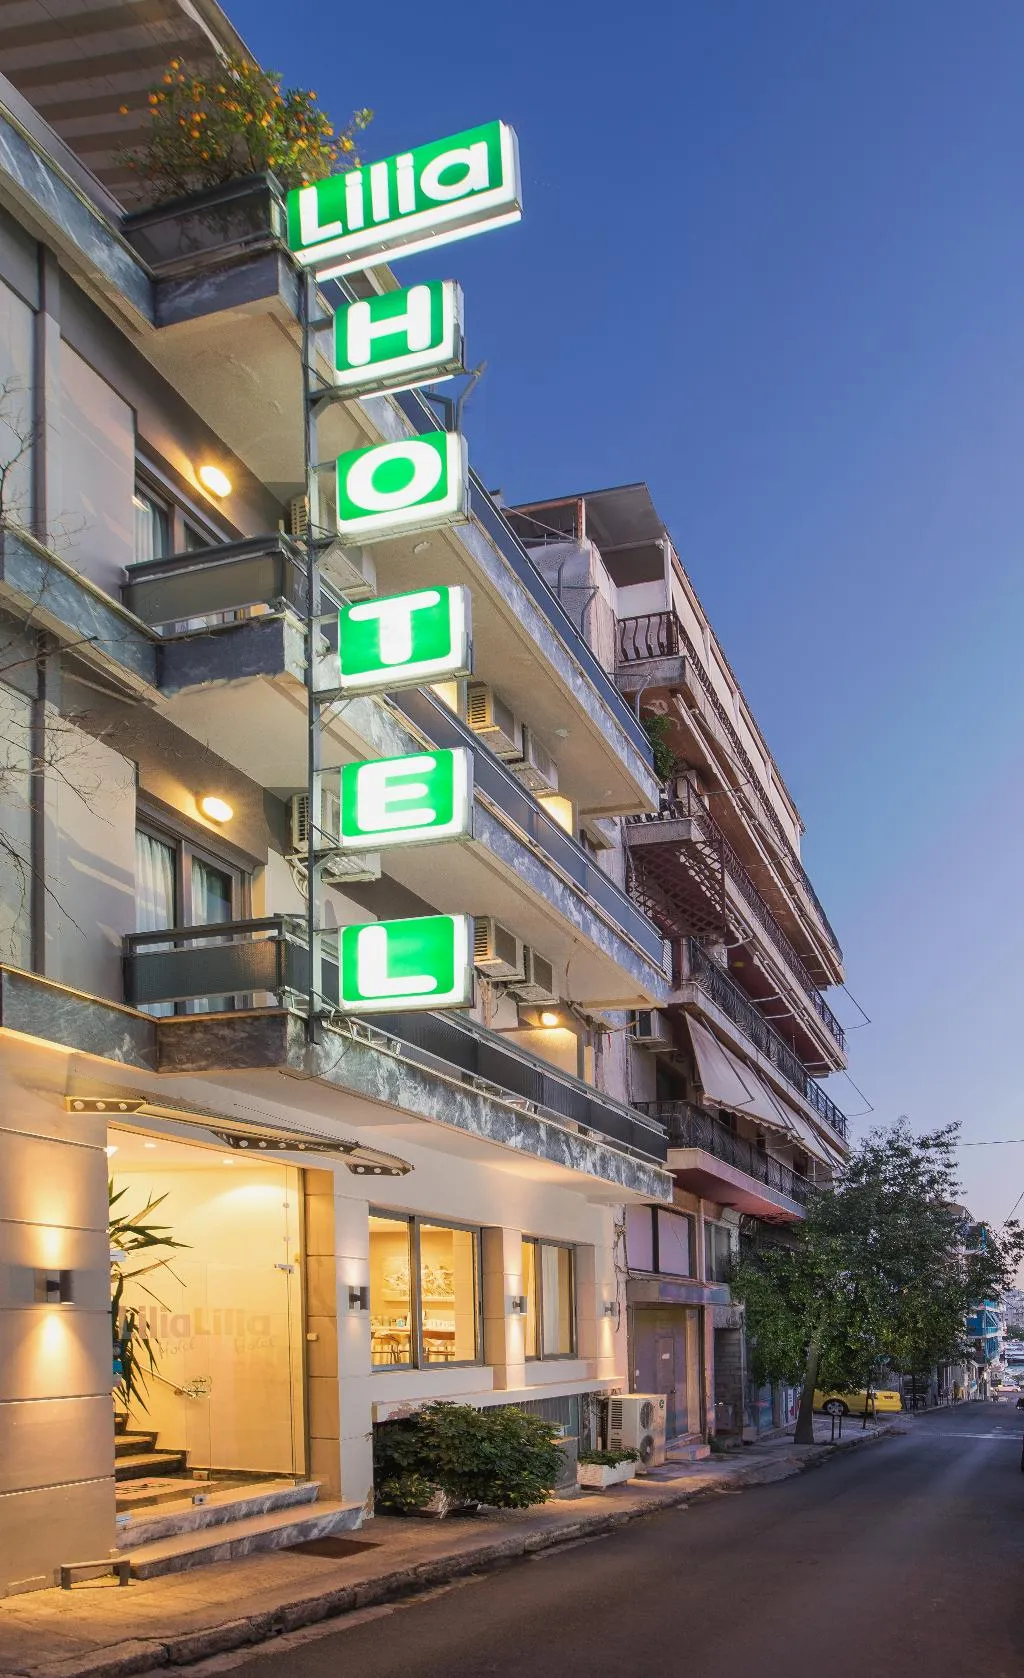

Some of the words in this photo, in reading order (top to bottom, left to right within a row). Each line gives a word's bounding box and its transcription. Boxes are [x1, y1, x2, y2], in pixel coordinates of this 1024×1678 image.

[299, 141, 489, 247] Lilia
[346, 285, 443, 998] HOTEL
[194, 1307, 271, 1337] Lilia
